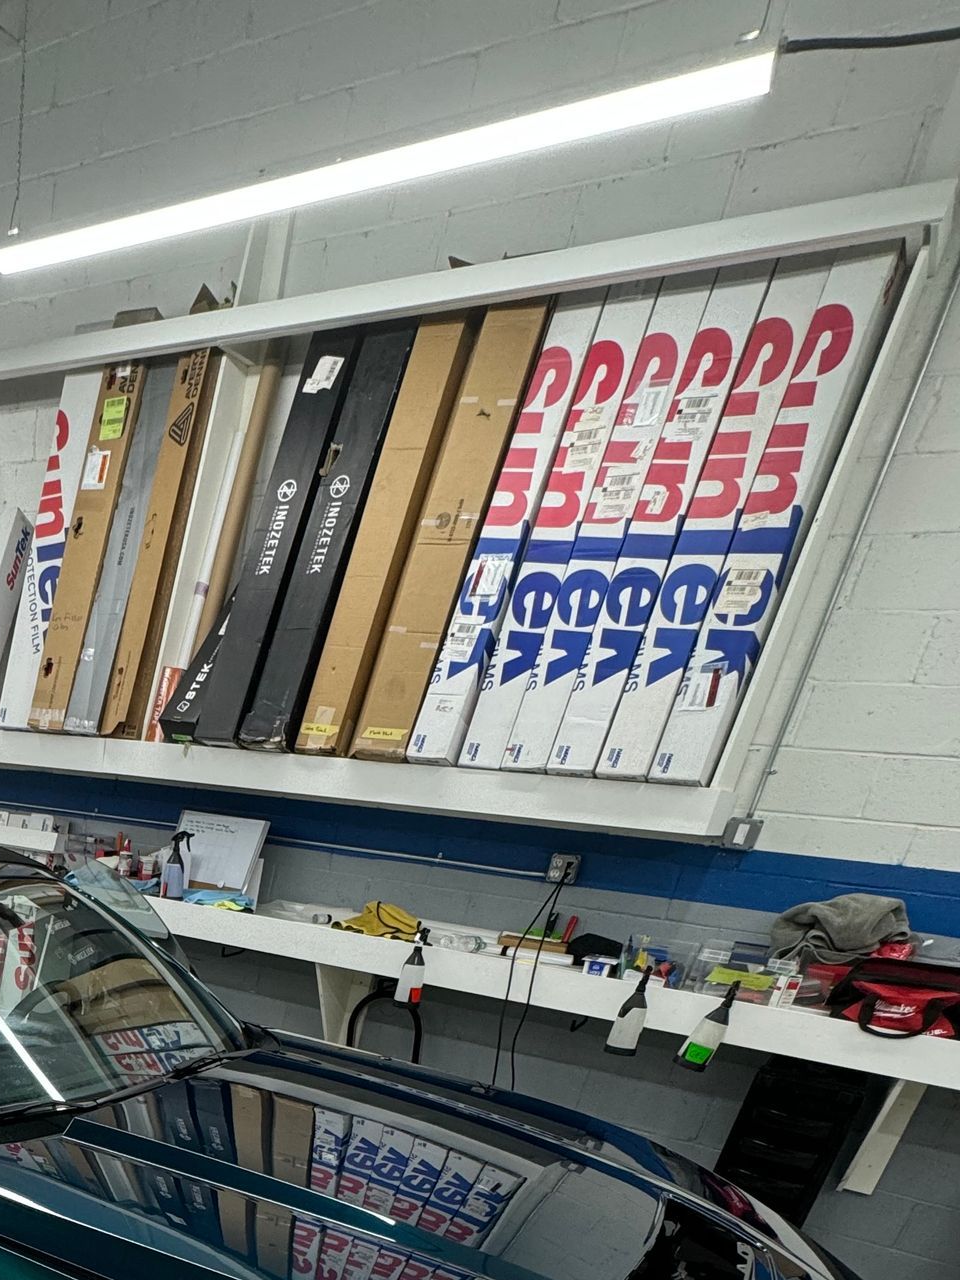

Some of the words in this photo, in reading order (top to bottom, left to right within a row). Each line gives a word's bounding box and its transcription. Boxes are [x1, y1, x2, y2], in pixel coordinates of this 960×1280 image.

[6, 527, 31, 591] SunTek
[259, 505, 290, 575] INOZETEK
[310, 501, 343, 574] INOZETEK
[31, 625, 41, 655] FILM
